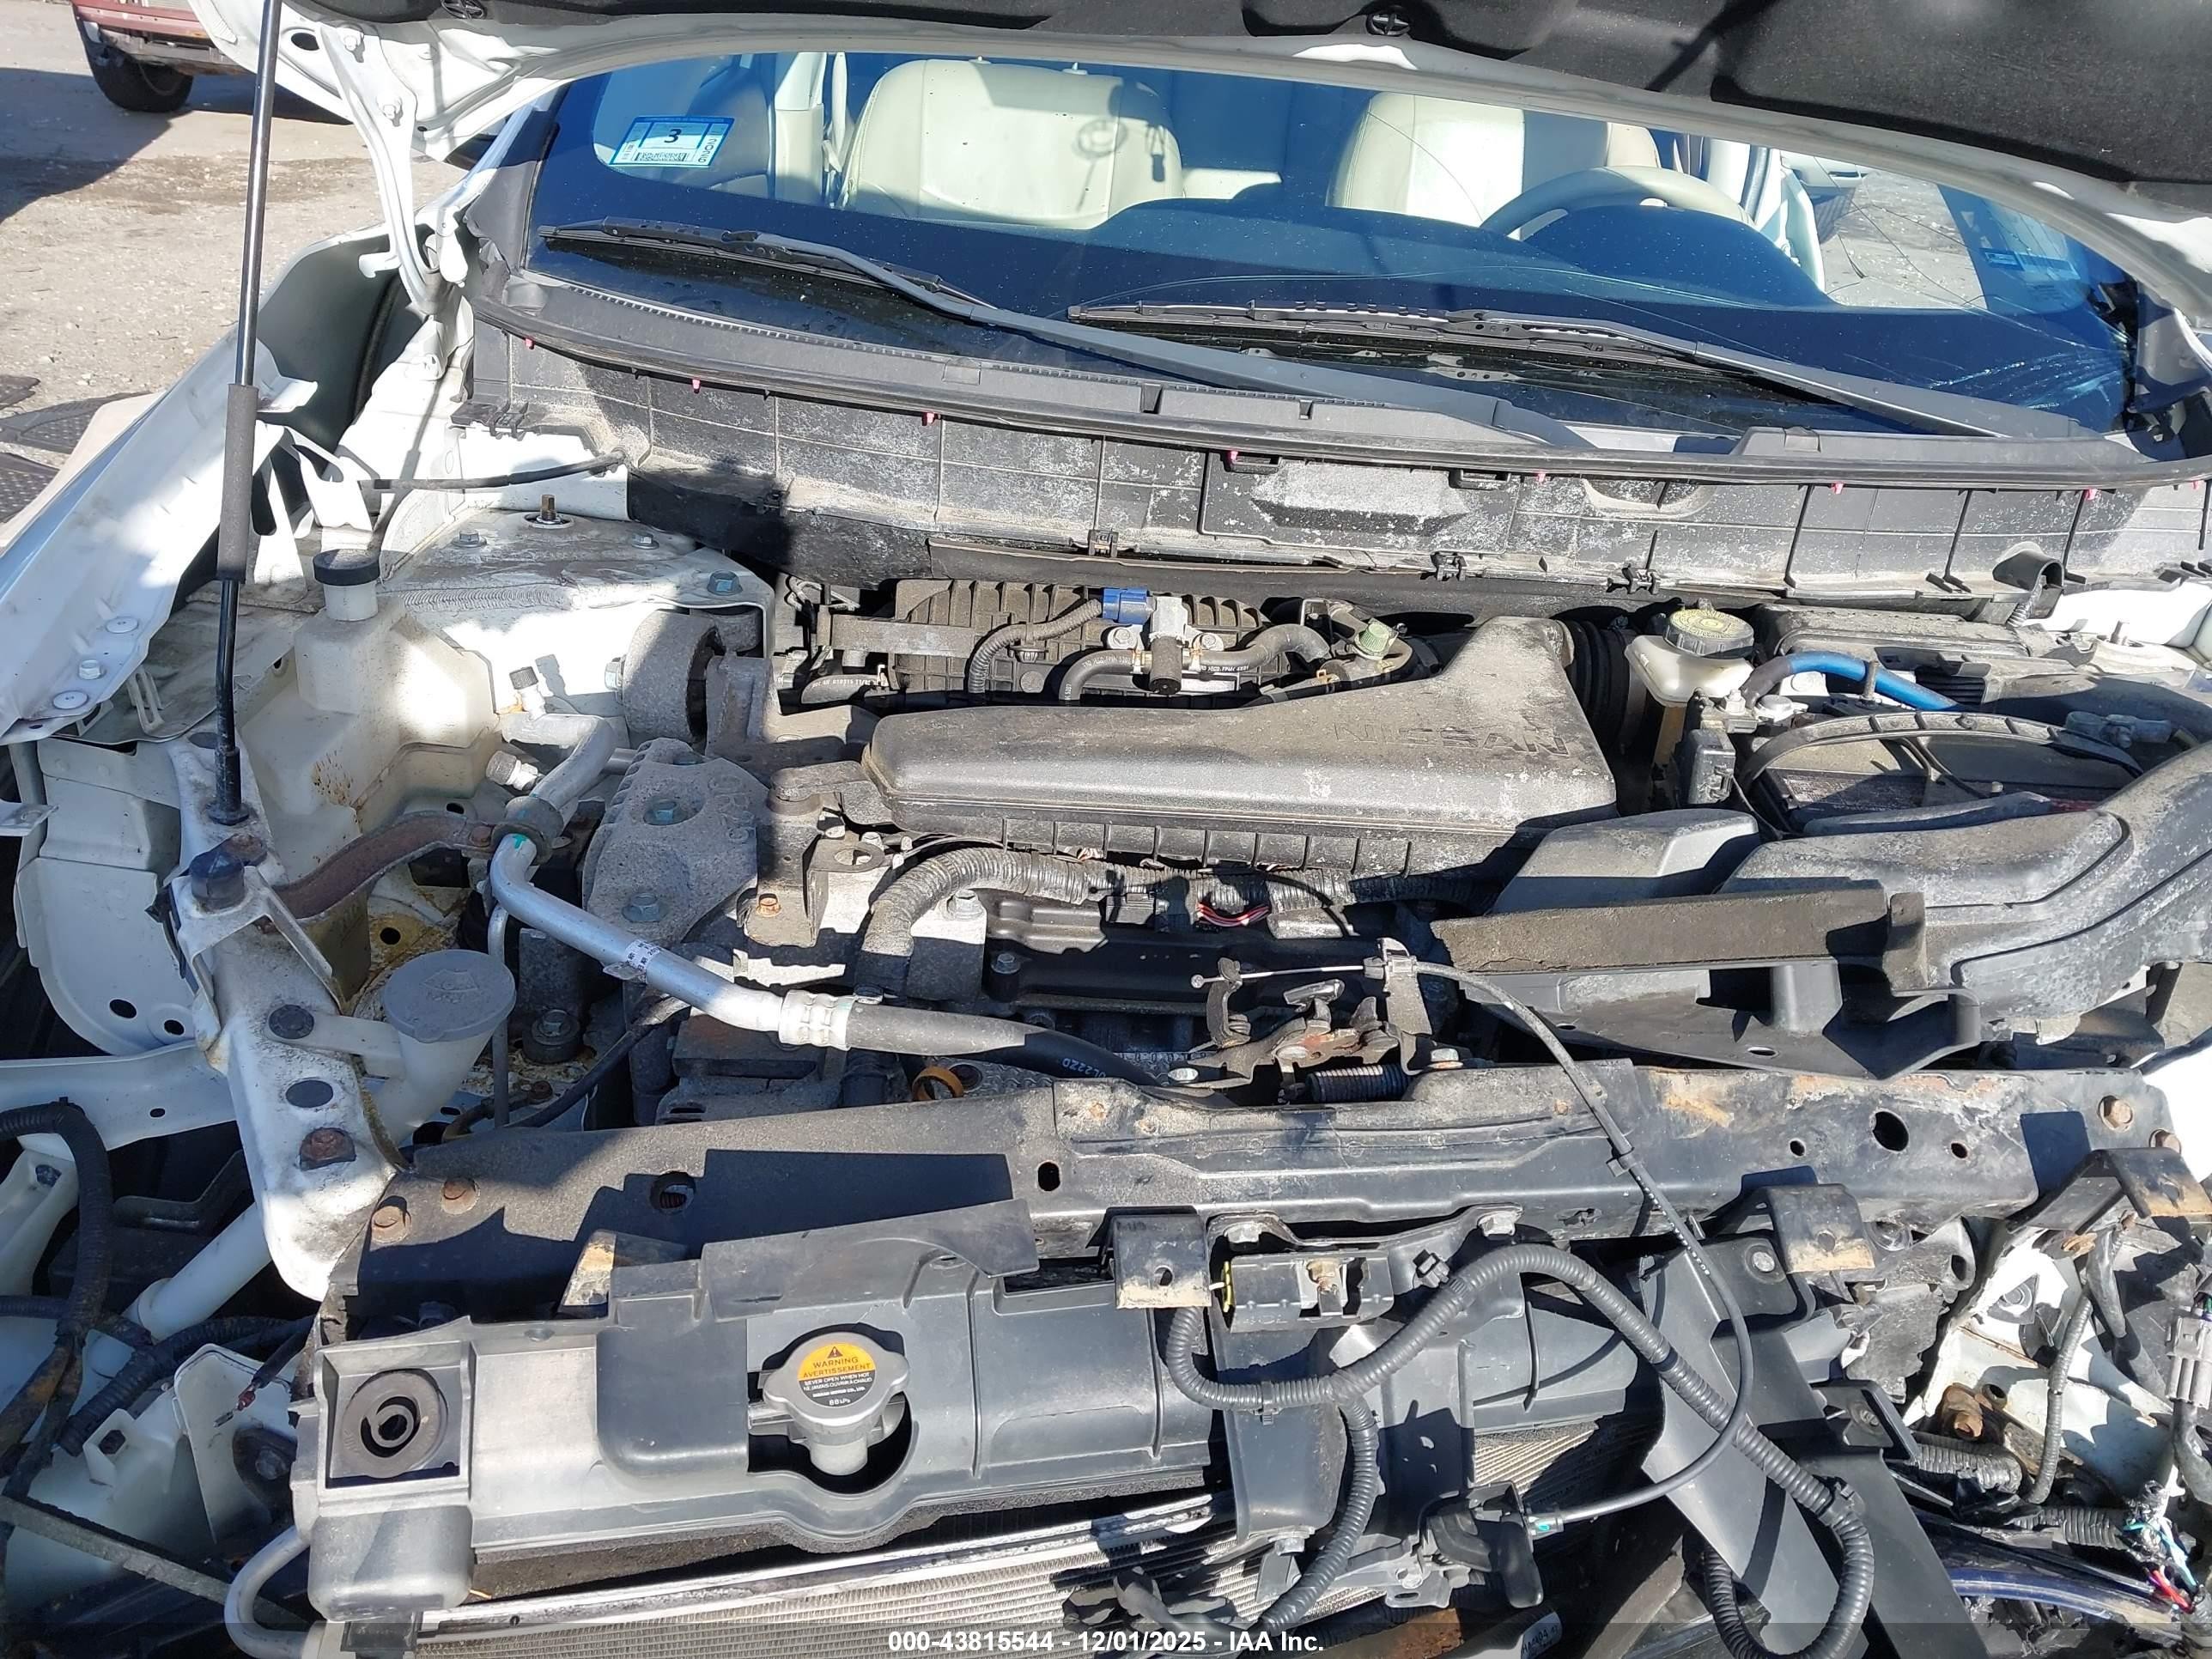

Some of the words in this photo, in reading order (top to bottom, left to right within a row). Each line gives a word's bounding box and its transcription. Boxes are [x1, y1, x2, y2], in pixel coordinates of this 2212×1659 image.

[664, 128, 682, 143] 3
[697, 138, 718, 163] 2026
[1333, 722, 1570, 756] NISSAN
[803, 1363, 871, 1378] AVERTISSEMENT
[813, 1357, 859, 1369] WARNING
[804, 1377, 823, 1386] NEVER
[840, 1373, 858, 1382] WHEN
